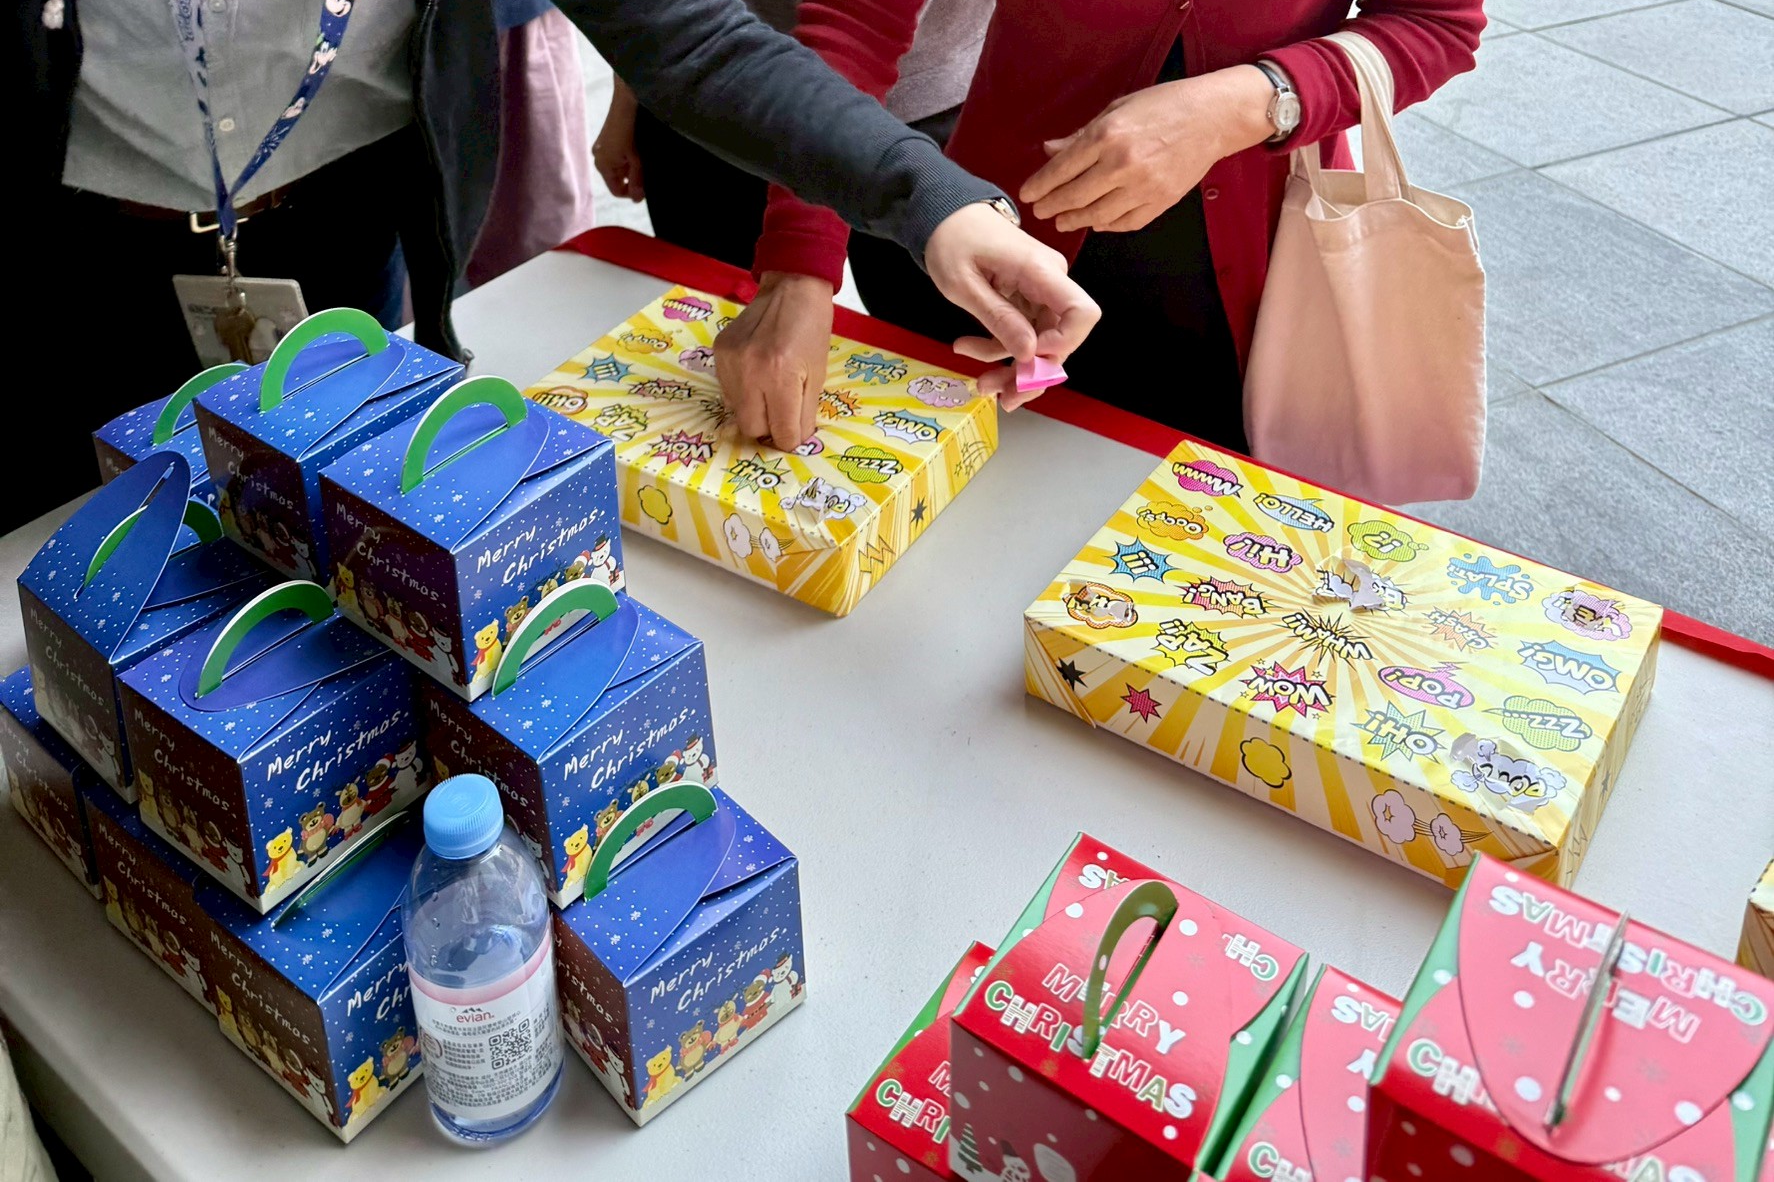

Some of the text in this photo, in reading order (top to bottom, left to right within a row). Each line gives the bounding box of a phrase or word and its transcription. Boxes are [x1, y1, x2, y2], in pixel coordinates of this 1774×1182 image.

[207, 427, 245, 461] Merry
[873, 412, 939, 441] OMG!
[730, 460, 781, 489] OH!
[335, 502, 381, 543] Merry
[1253, 493, 1335, 533] HELLO!
[477, 526, 537, 574] Merry
[1121, 550, 1159, 575] !!!
[1182, 583, 1267, 616] BANG!
[30, 607, 63, 649] Merry
[1156, 618, 1230, 676] ZAP!!
[1282, 614, 1374, 660] WHAM!!
[1517, 643, 1616, 690] OMG!
[1385, 670, 1465, 710] POP!
[134, 709, 176, 752] Merry
[430, 699, 472, 744] Merry
[1366, 711, 1438, 755] OH!
[267, 729, 332, 781] Merry
[564, 729, 624, 781] Merry
[98, 822, 137, 867] Merry
[210, 930, 253, 979] Merry
[650, 952, 714, 1004] Merry
